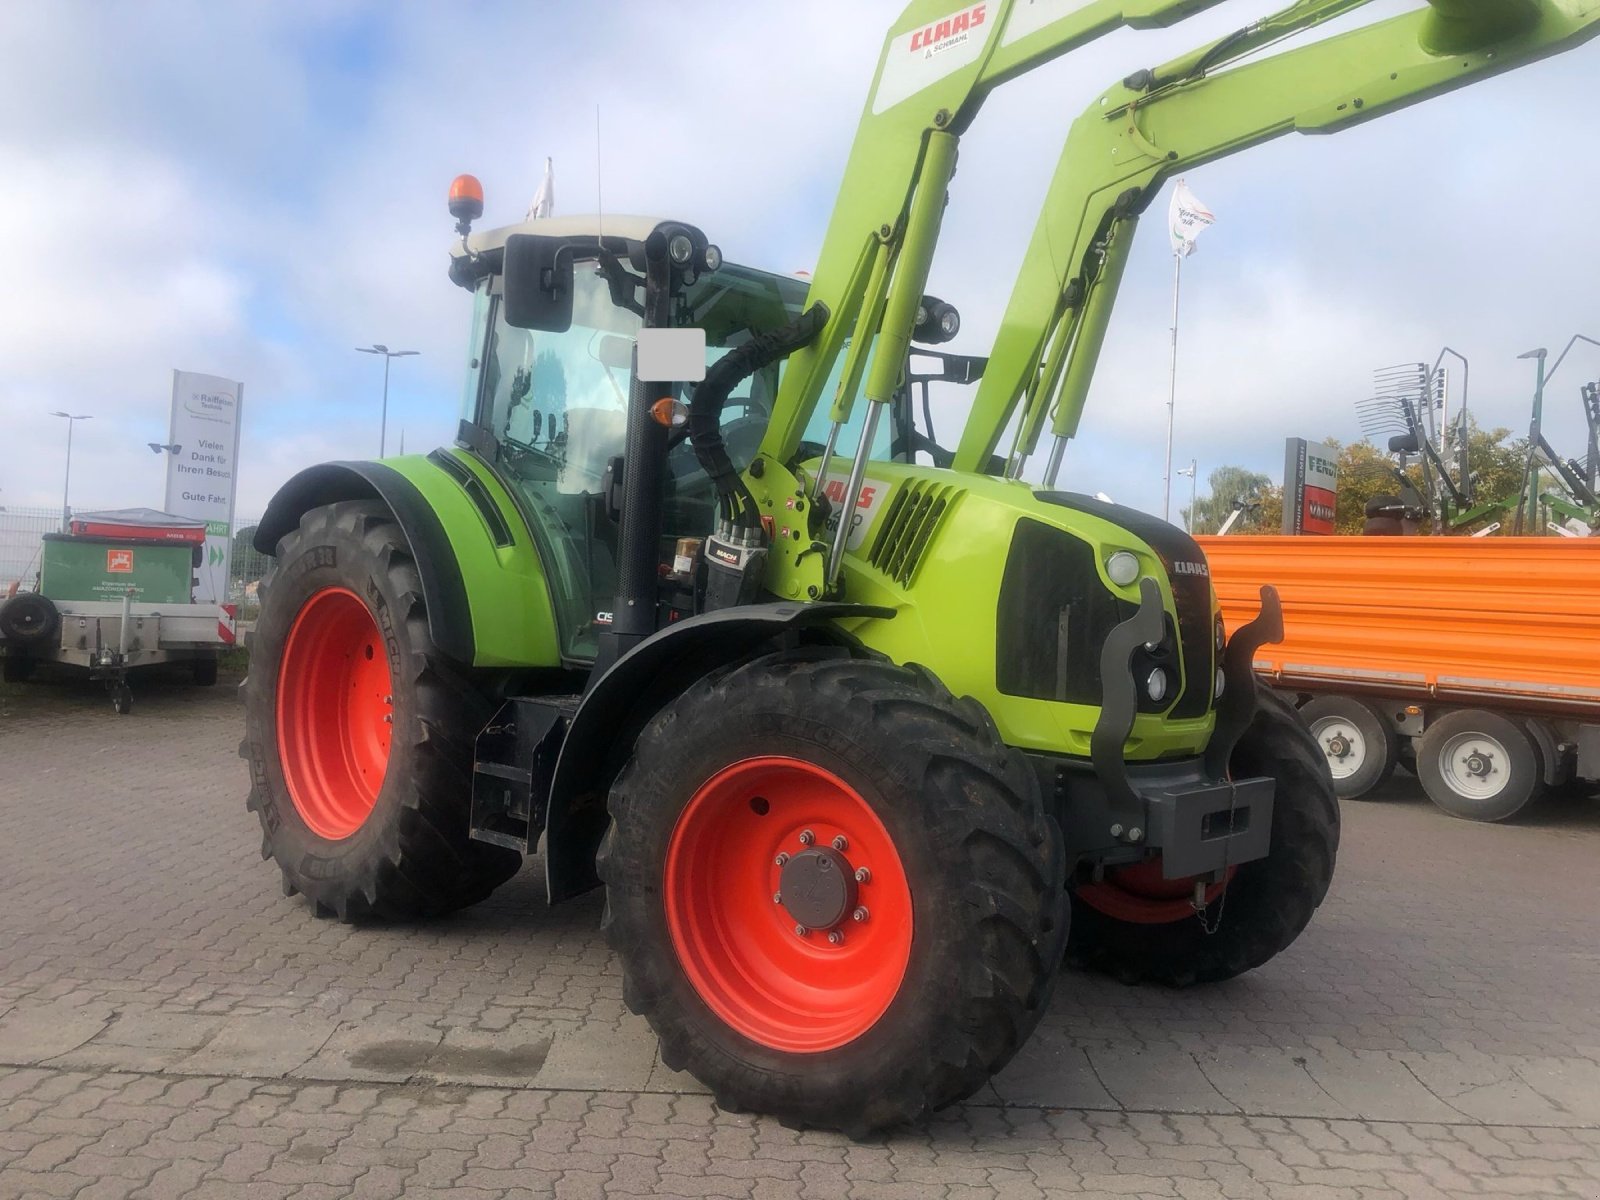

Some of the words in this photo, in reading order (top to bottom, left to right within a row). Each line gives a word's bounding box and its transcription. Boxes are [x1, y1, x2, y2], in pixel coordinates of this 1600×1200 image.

[910, 5, 986, 52] CLAAS
[933, 34, 968, 53] SCHMAHL
[198, 439, 225, 451] Vielen
[191, 452, 215, 463] Dank
[177, 463, 204, 475] Ihren
[182, 491, 206, 502] Gute
[207, 523, 228, 535] AHRT
[1174, 561, 1208, 576] CLAAS
